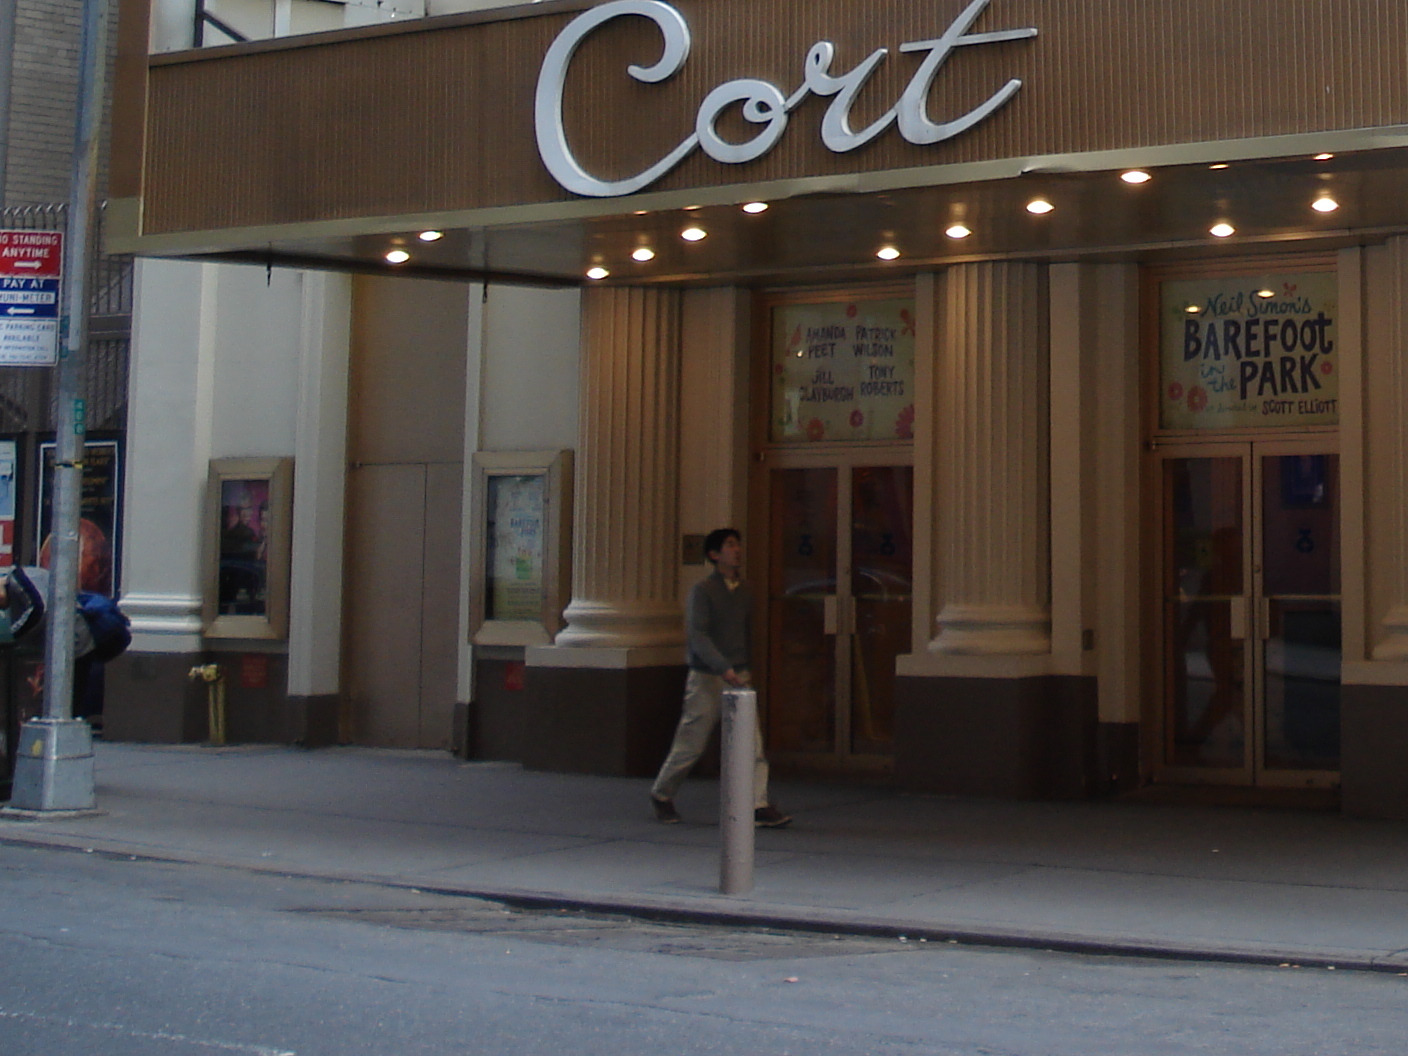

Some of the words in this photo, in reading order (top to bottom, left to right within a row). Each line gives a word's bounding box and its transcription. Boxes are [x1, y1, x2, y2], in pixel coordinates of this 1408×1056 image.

[12, 234, 57, 245] STANDING
[2, 247, 50, 258] ANYTIME
[3, 279, 26, 288] PAY
[30, 279, 45, 289] AT
[1202, 293, 1243, 316] Neil
[1247, 290, 1312, 318] Simon's
[808, 343, 836, 359] PEET
[853, 343, 893, 358] WILSON
[869, 365, 895, 379] TONY
[1201, 364, 1225, 378] in
[1240, 353, 1322, 400] PARK
[860, 380, 904, 396] ROBERTS
[1208, 375, 1236, 393] the
[1261, 400, 1295, 415] SCOTT
